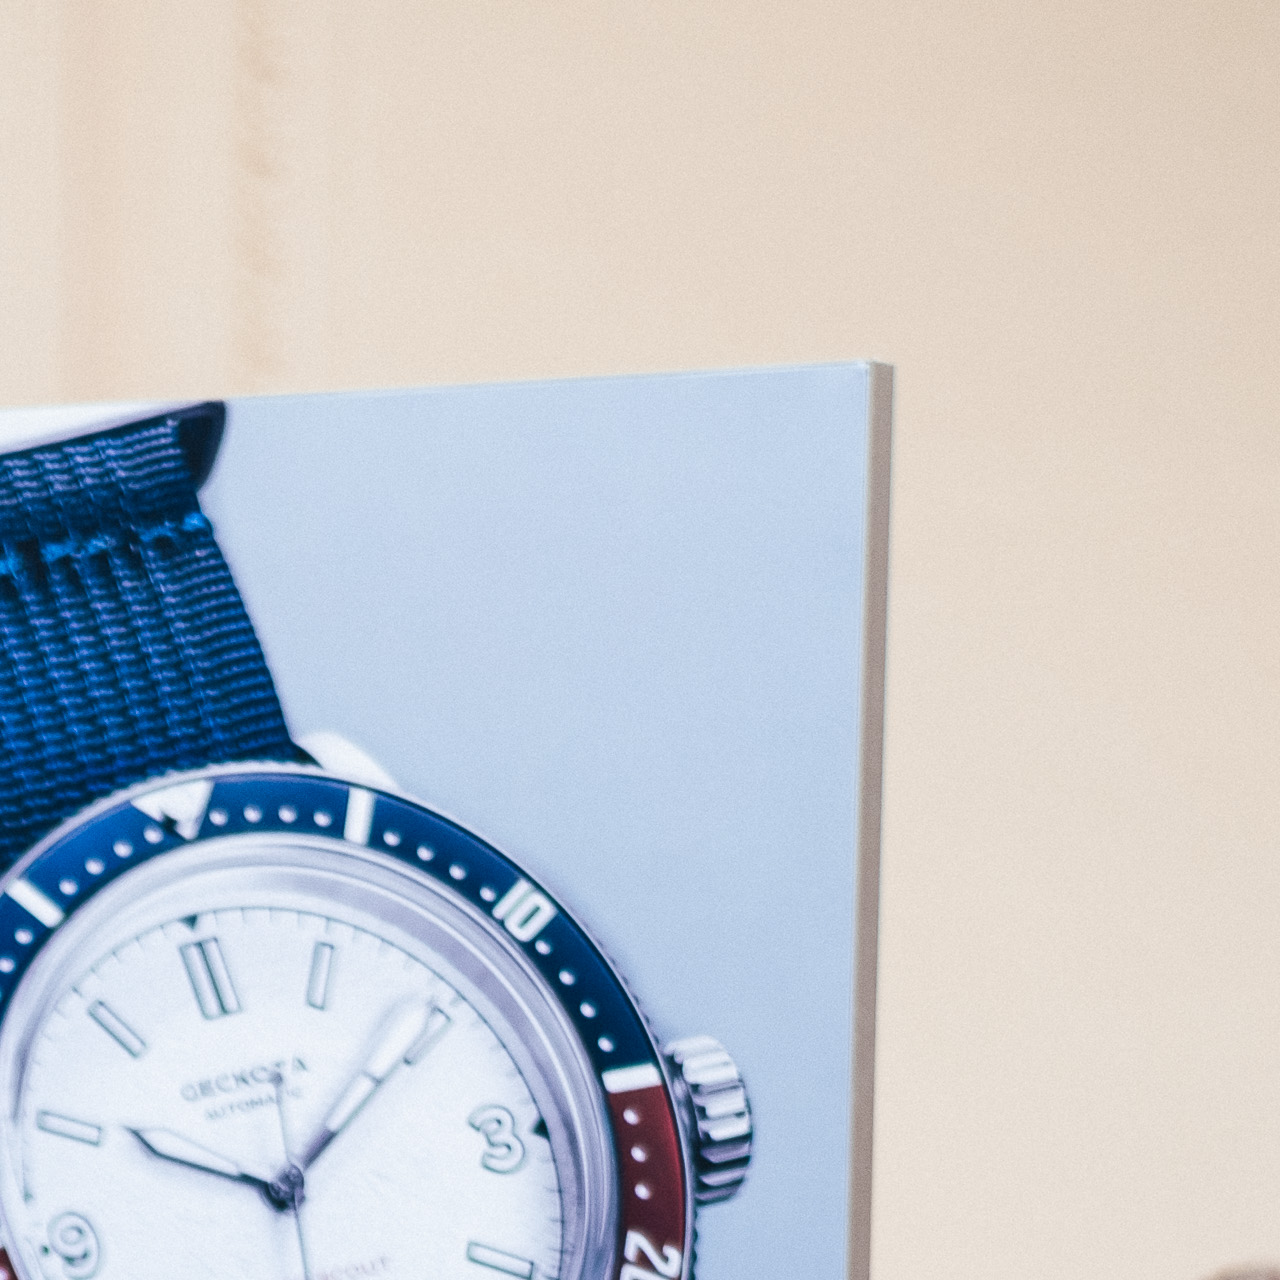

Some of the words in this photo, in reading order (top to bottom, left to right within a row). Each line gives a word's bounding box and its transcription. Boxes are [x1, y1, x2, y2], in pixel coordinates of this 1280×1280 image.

[492, 878, 558, 942] 10
[467, 1104, 526, 1174] 3
[47, 1208, 101, 1280] 9
